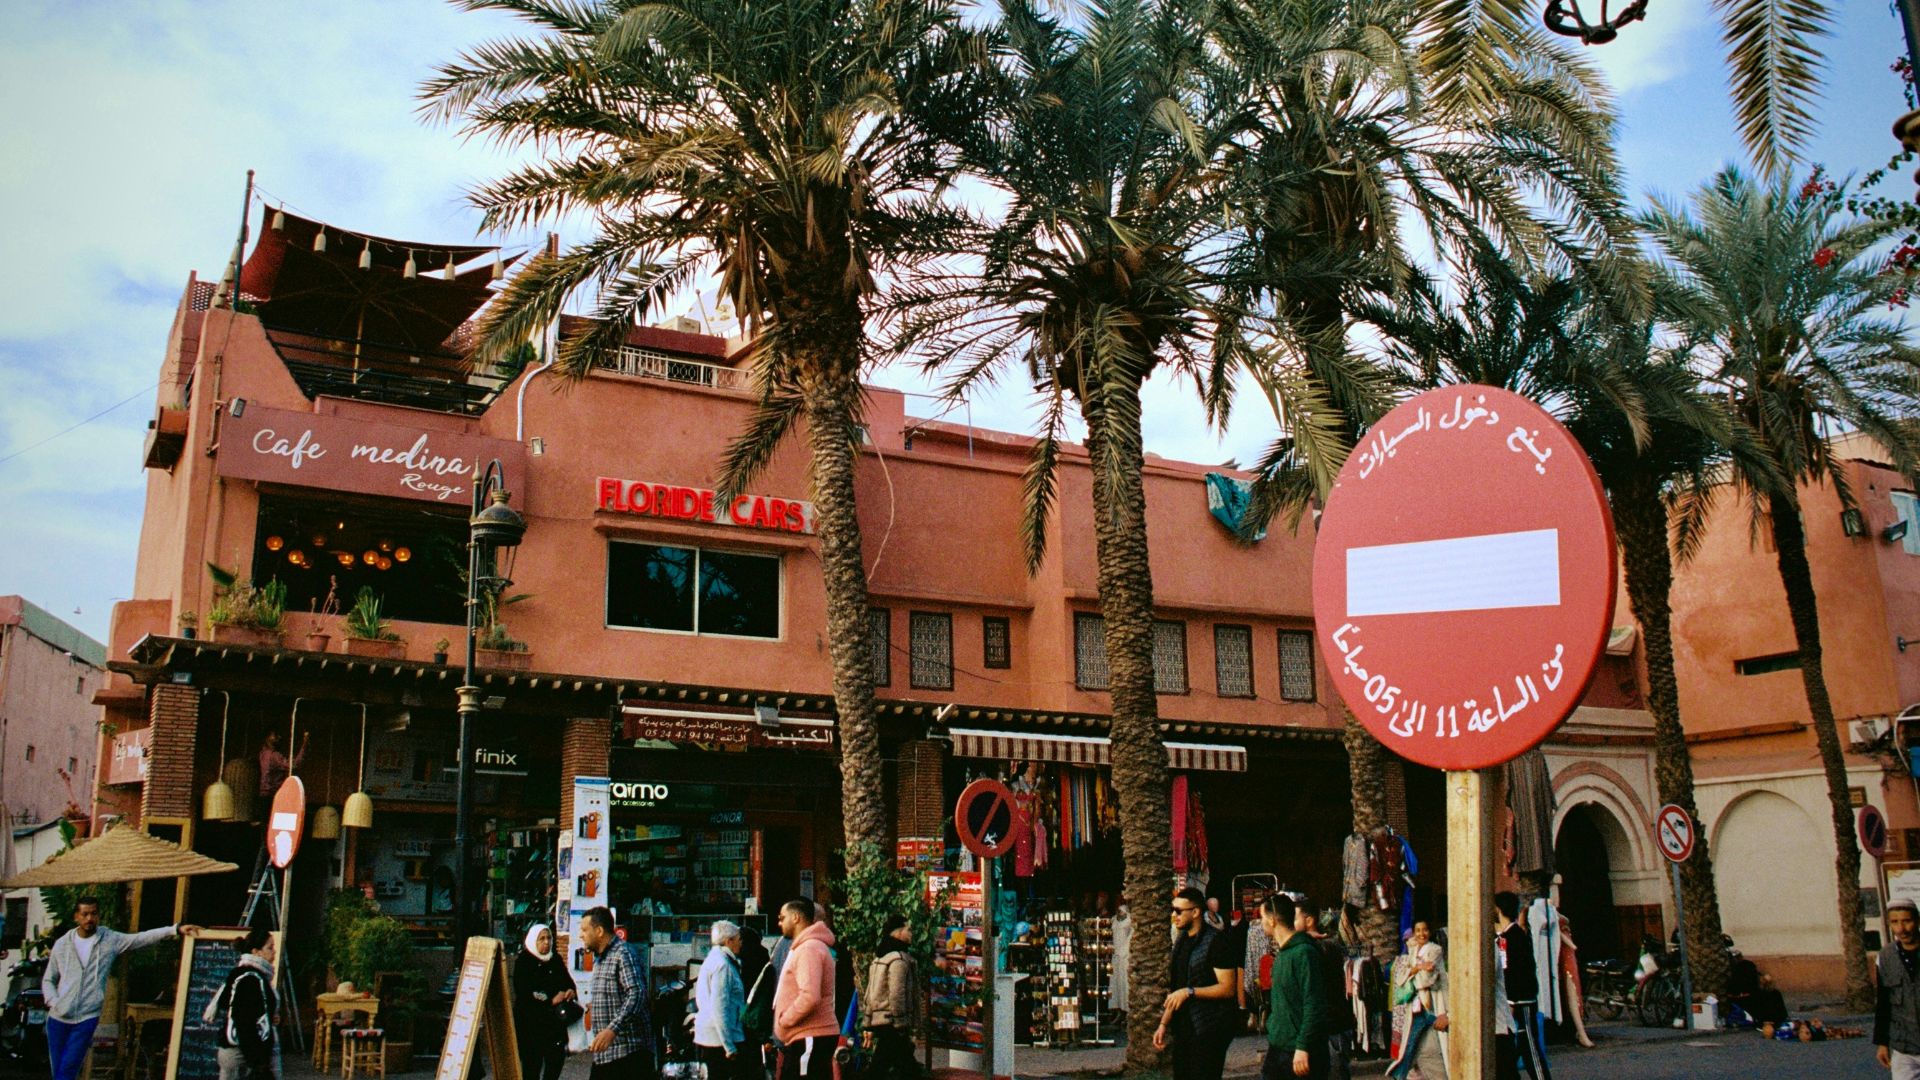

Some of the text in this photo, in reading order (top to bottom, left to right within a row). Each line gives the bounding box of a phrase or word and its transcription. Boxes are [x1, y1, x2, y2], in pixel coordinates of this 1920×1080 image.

[1439, 394, 1500, 431] دخول
[252, 429, 471, 476] Cafe medina
[1358, 406, 1431, 480] السيارات
[400, 473, 465, 500] Rouge
[600, 478, 806, 532] FLORIDE CARS
[1542, 643, 1564, 691] من
[1363, 674, 1402, 714] 05
[1463, 674, 1540, 734] الساعة
[645, 728, 657, 737] 05
[659, 729, 672, 739] 24
[689, 731, 701, 740] 94
[703, 732, 715, 740] 94
[1435, 705, 1460, 737] 11
[456, 747, 518, 765] Ifinix
[609, 782, 669, 801] raimo
[710, 811, 743, 824] HONOR
